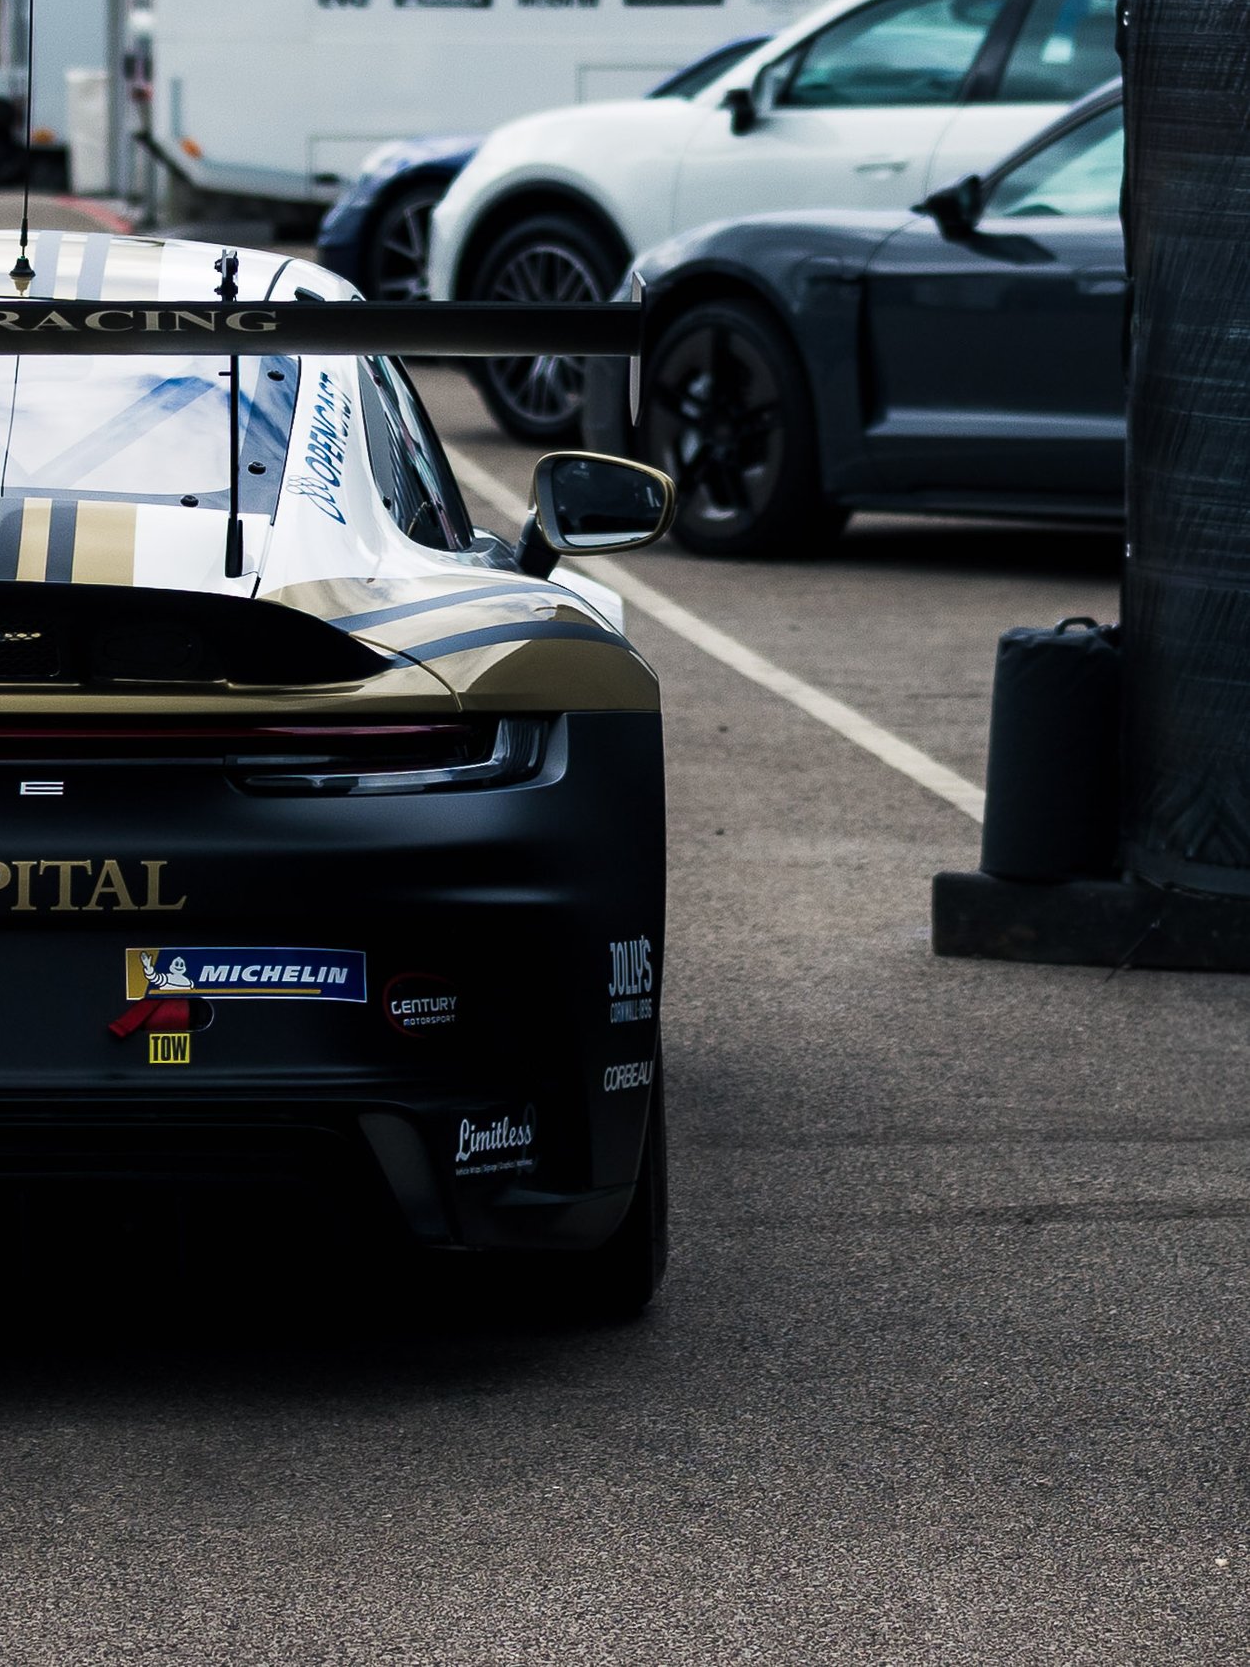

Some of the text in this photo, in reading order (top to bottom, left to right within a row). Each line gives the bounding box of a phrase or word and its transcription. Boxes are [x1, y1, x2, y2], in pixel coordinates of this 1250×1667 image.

[199, 964, 349, 985] MICHELIN
[608, 935, 653, 997] JOLLY'S
[391, 996, 457, 1015] CENTURY
[151, 1035, 188, 1062] TOW
[603, 1061, 653, 1092] CORBEAU
[456, 1116, 532, 1161] Limitless
